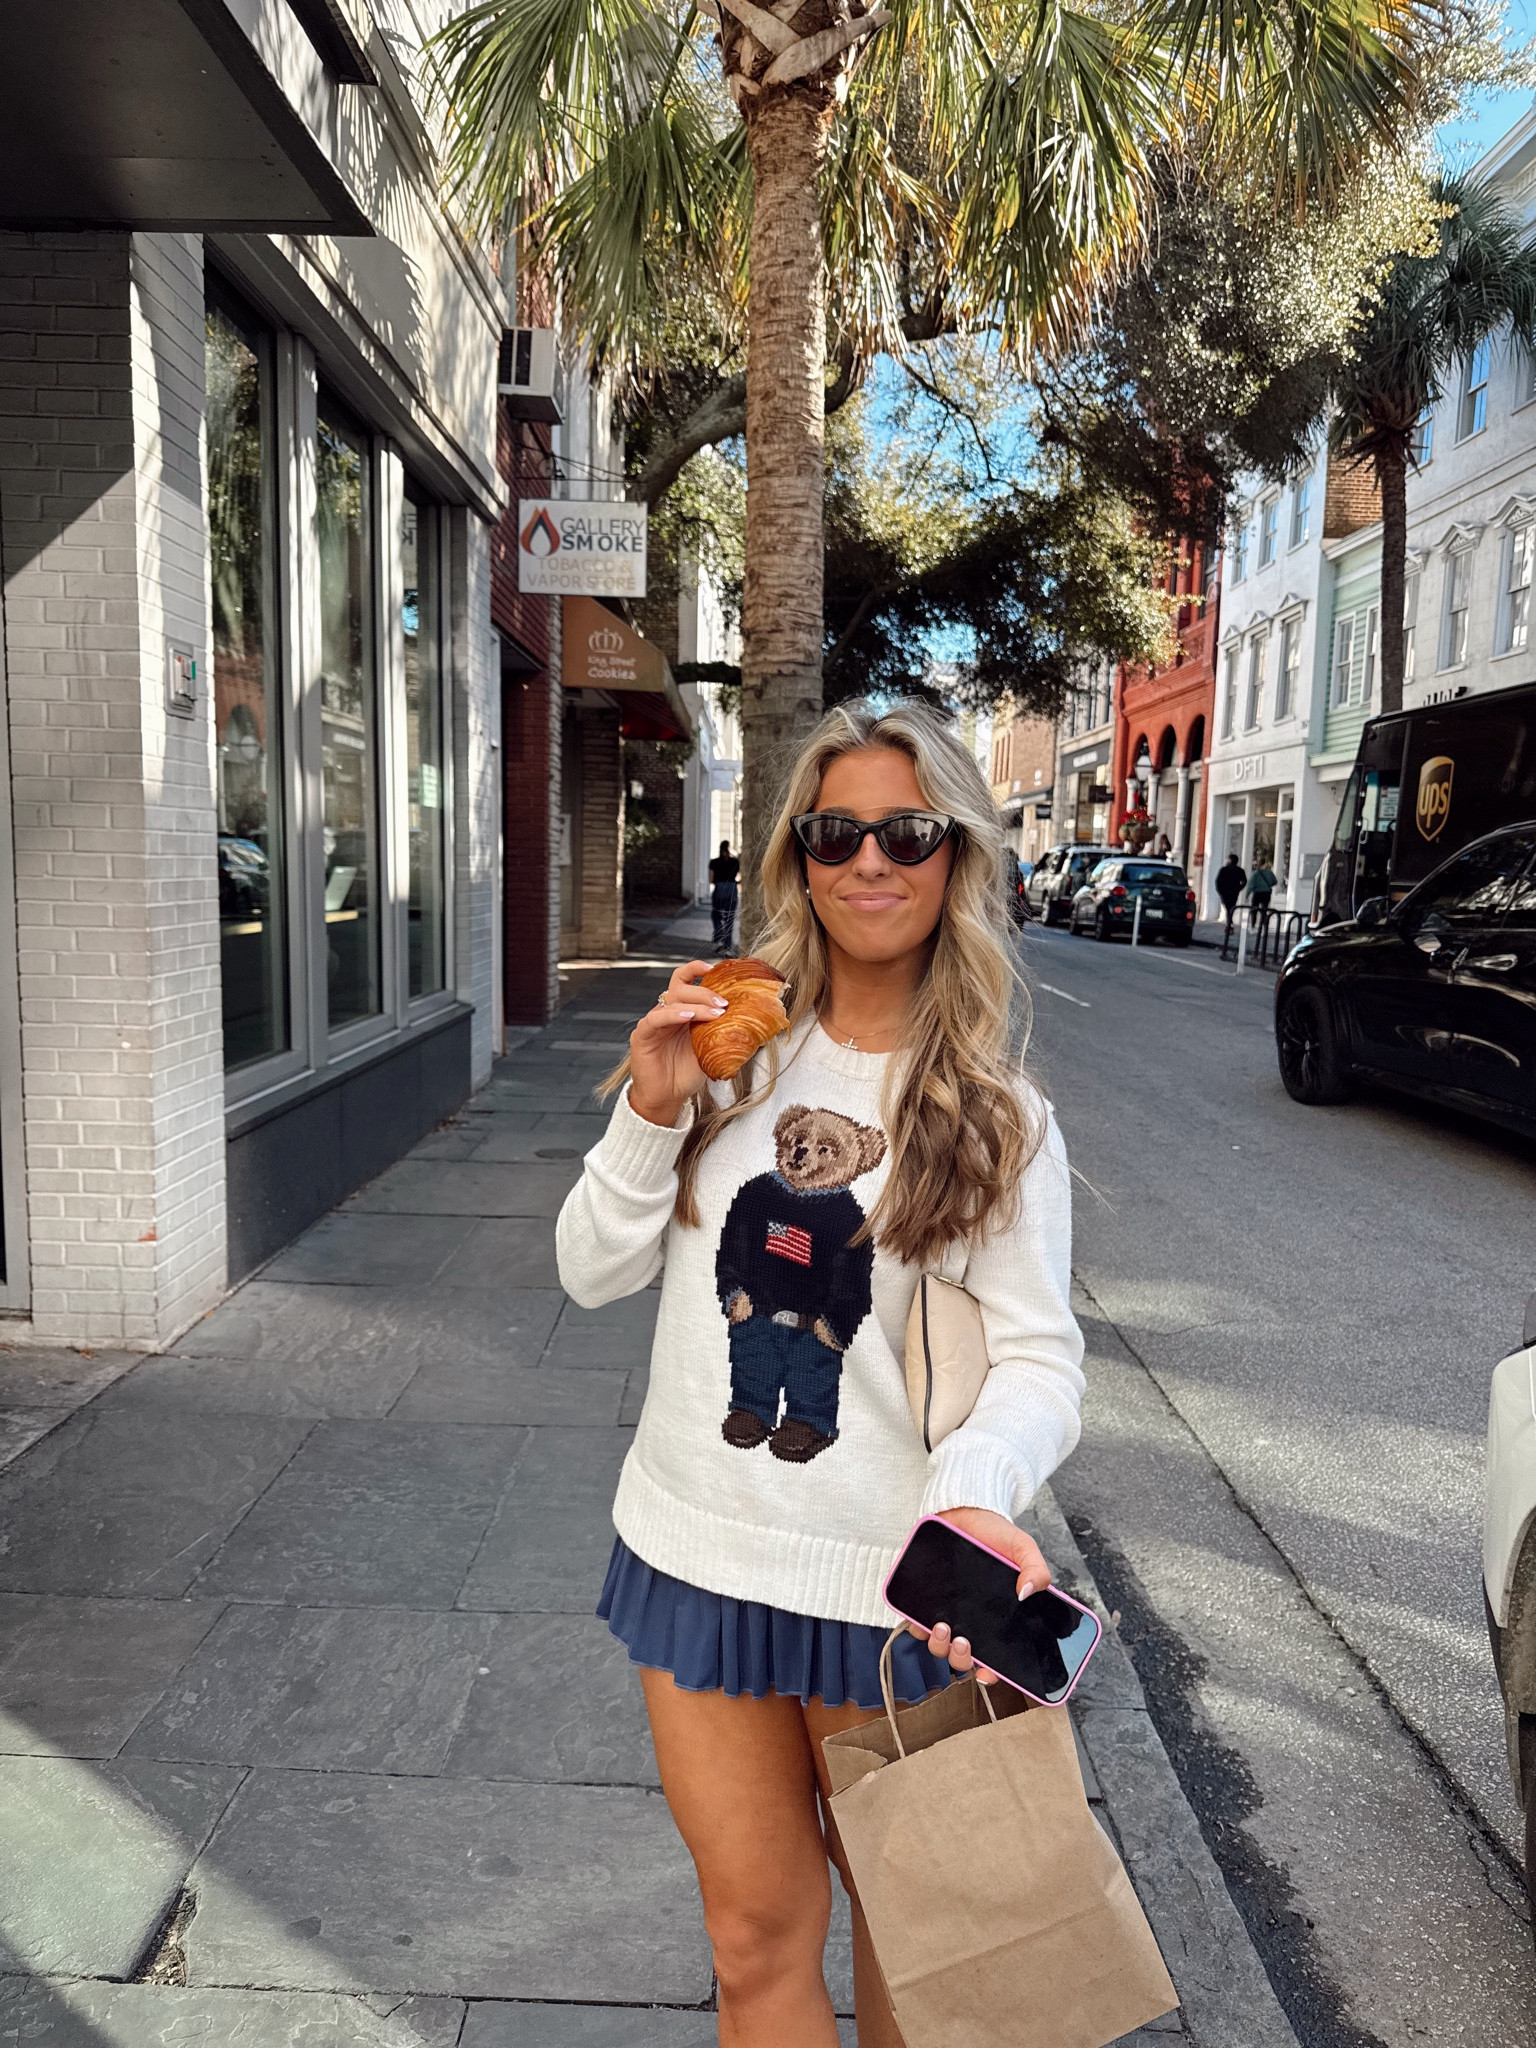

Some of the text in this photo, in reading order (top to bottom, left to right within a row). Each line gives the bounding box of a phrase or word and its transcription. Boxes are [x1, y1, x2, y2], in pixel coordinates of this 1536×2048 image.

[560, 517, 644, 537] GALLERY
[562, 534, 643, 553] SMOKE
[538, 557, 632, 574] TOBACCO &
[527, 574, 636, 591] VAPOR STORE
[587, 666, 637, 680] Cookies
[1418, 781, 1449, 828] ups
[775, 1312, 795, 1324] RL
